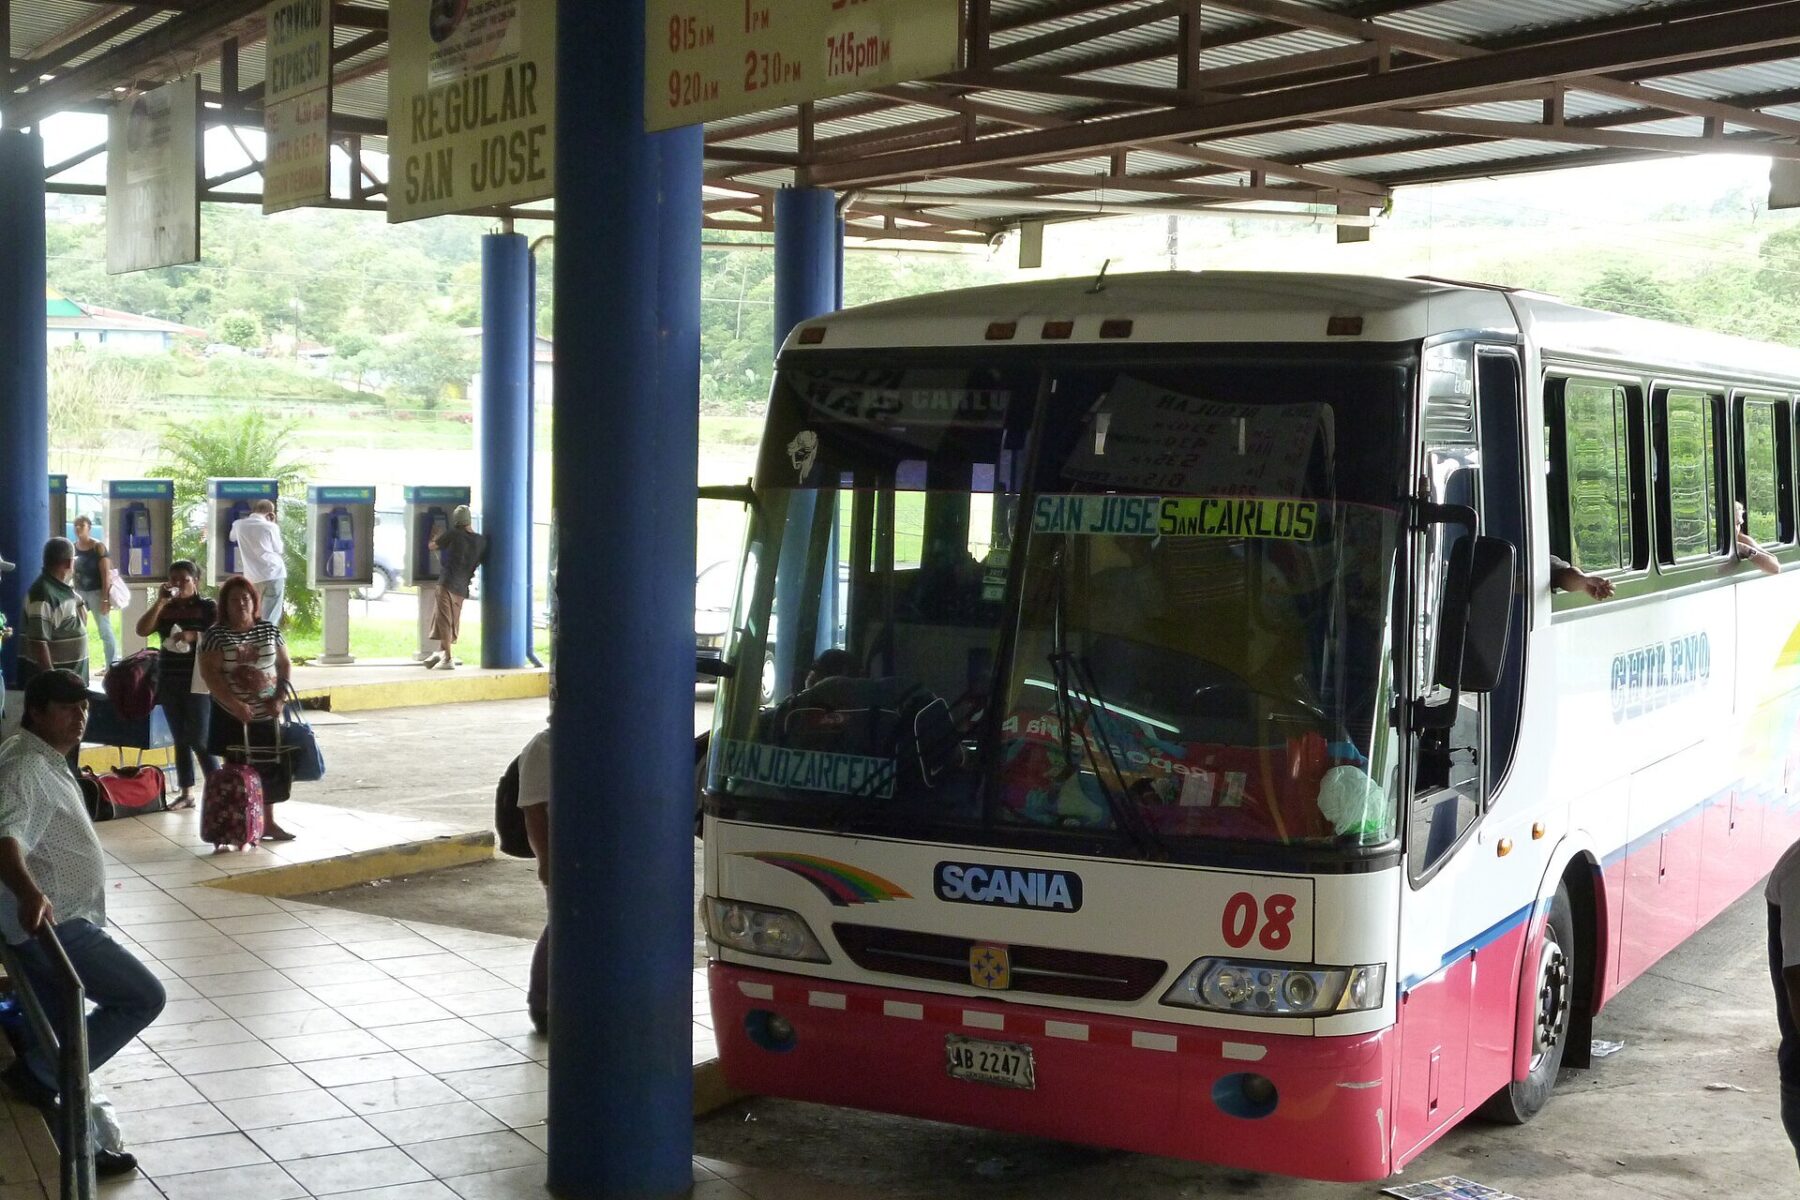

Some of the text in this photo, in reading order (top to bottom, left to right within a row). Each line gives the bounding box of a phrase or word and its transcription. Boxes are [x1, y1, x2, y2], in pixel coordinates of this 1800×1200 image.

[410, 60, 538, 144] REGULAR
[405, 123, 547, 205] SAN JOSE
[1034, 497, 1158, 534] SAN JOSE
[1610, 631, 1710, 711] CHILENO
[941, 864, 1075, 910] SCANIA
[1221, 891, 1298, 951] 08
